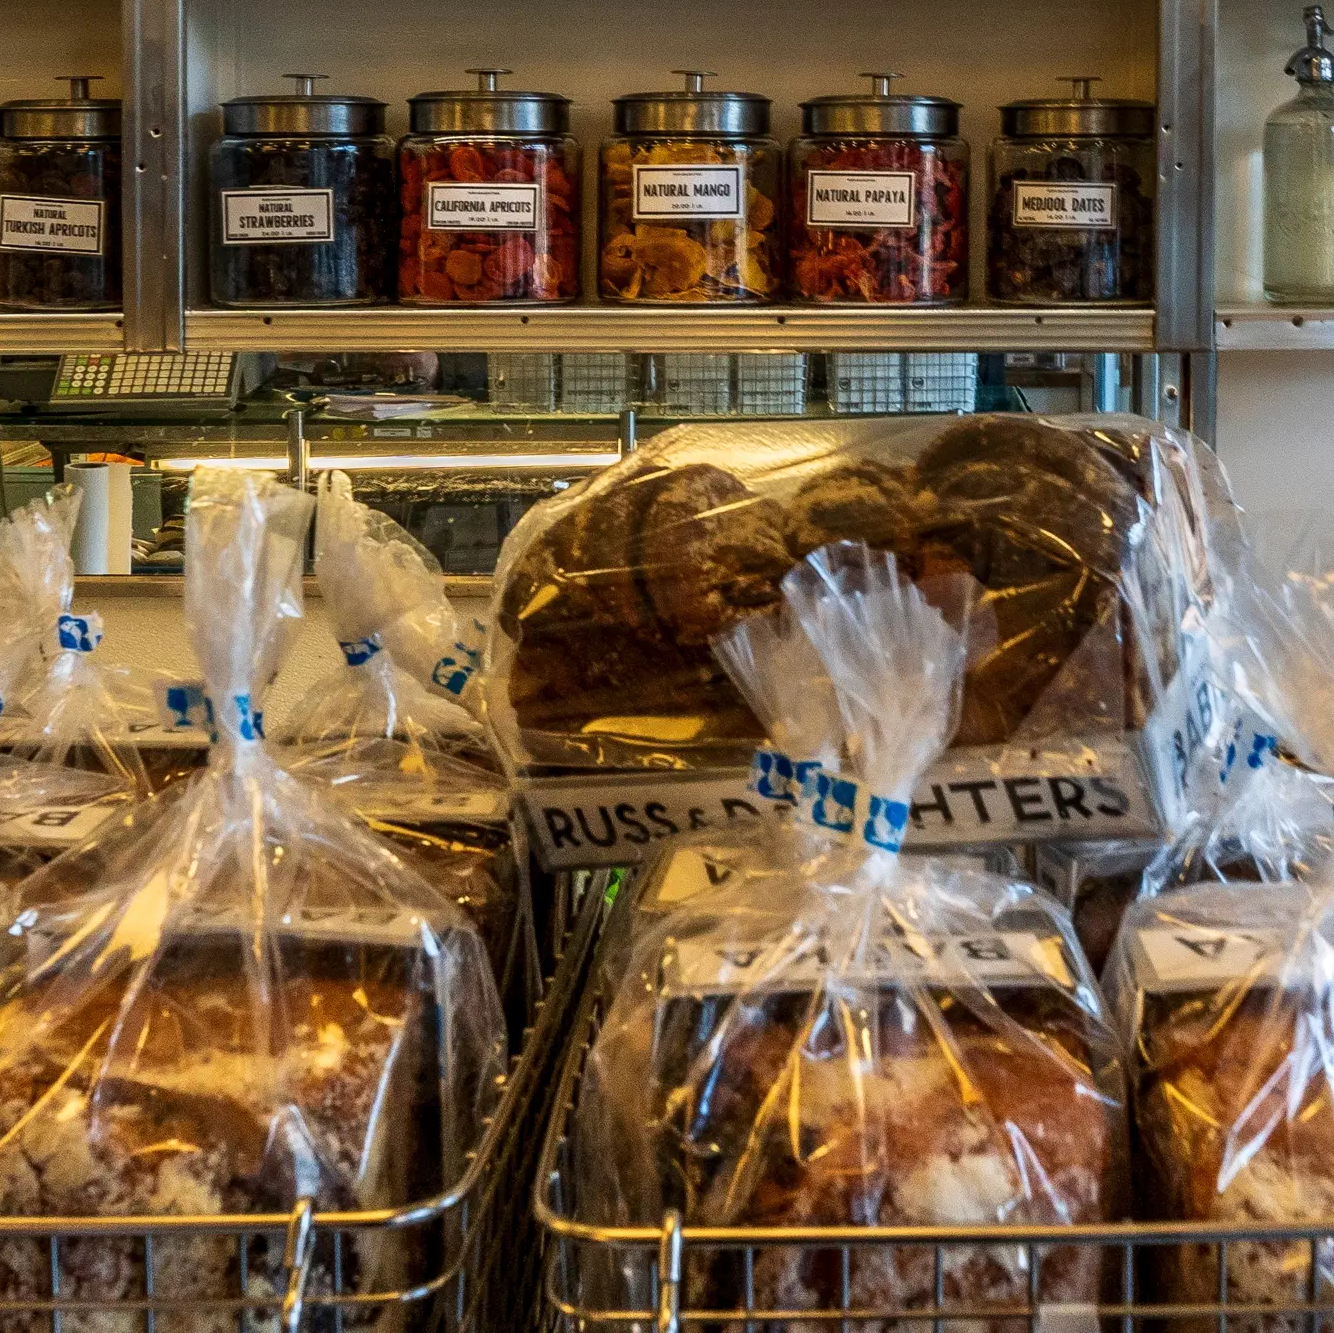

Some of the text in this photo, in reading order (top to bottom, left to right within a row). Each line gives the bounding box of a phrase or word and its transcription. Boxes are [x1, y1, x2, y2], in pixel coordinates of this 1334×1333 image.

[643, 182, 731, 197] NATURAL MANGO
[815, 188, 906, 204] NATURAL PAPAYA
[258, 203, 294, 213] NATURAL
[434, 199, 532, 213] CALIFORNIA APRICOTS
[1022, 196, 1105, 213] MEDJOOL DATES
[33, 209, 68, 220] NATURAL
[238, 214, 315, 228] STRAWBERRIES
[4, 219, 97, 238] TURKISH APRICOTS
[542, 801, 679, 851] RUSS
